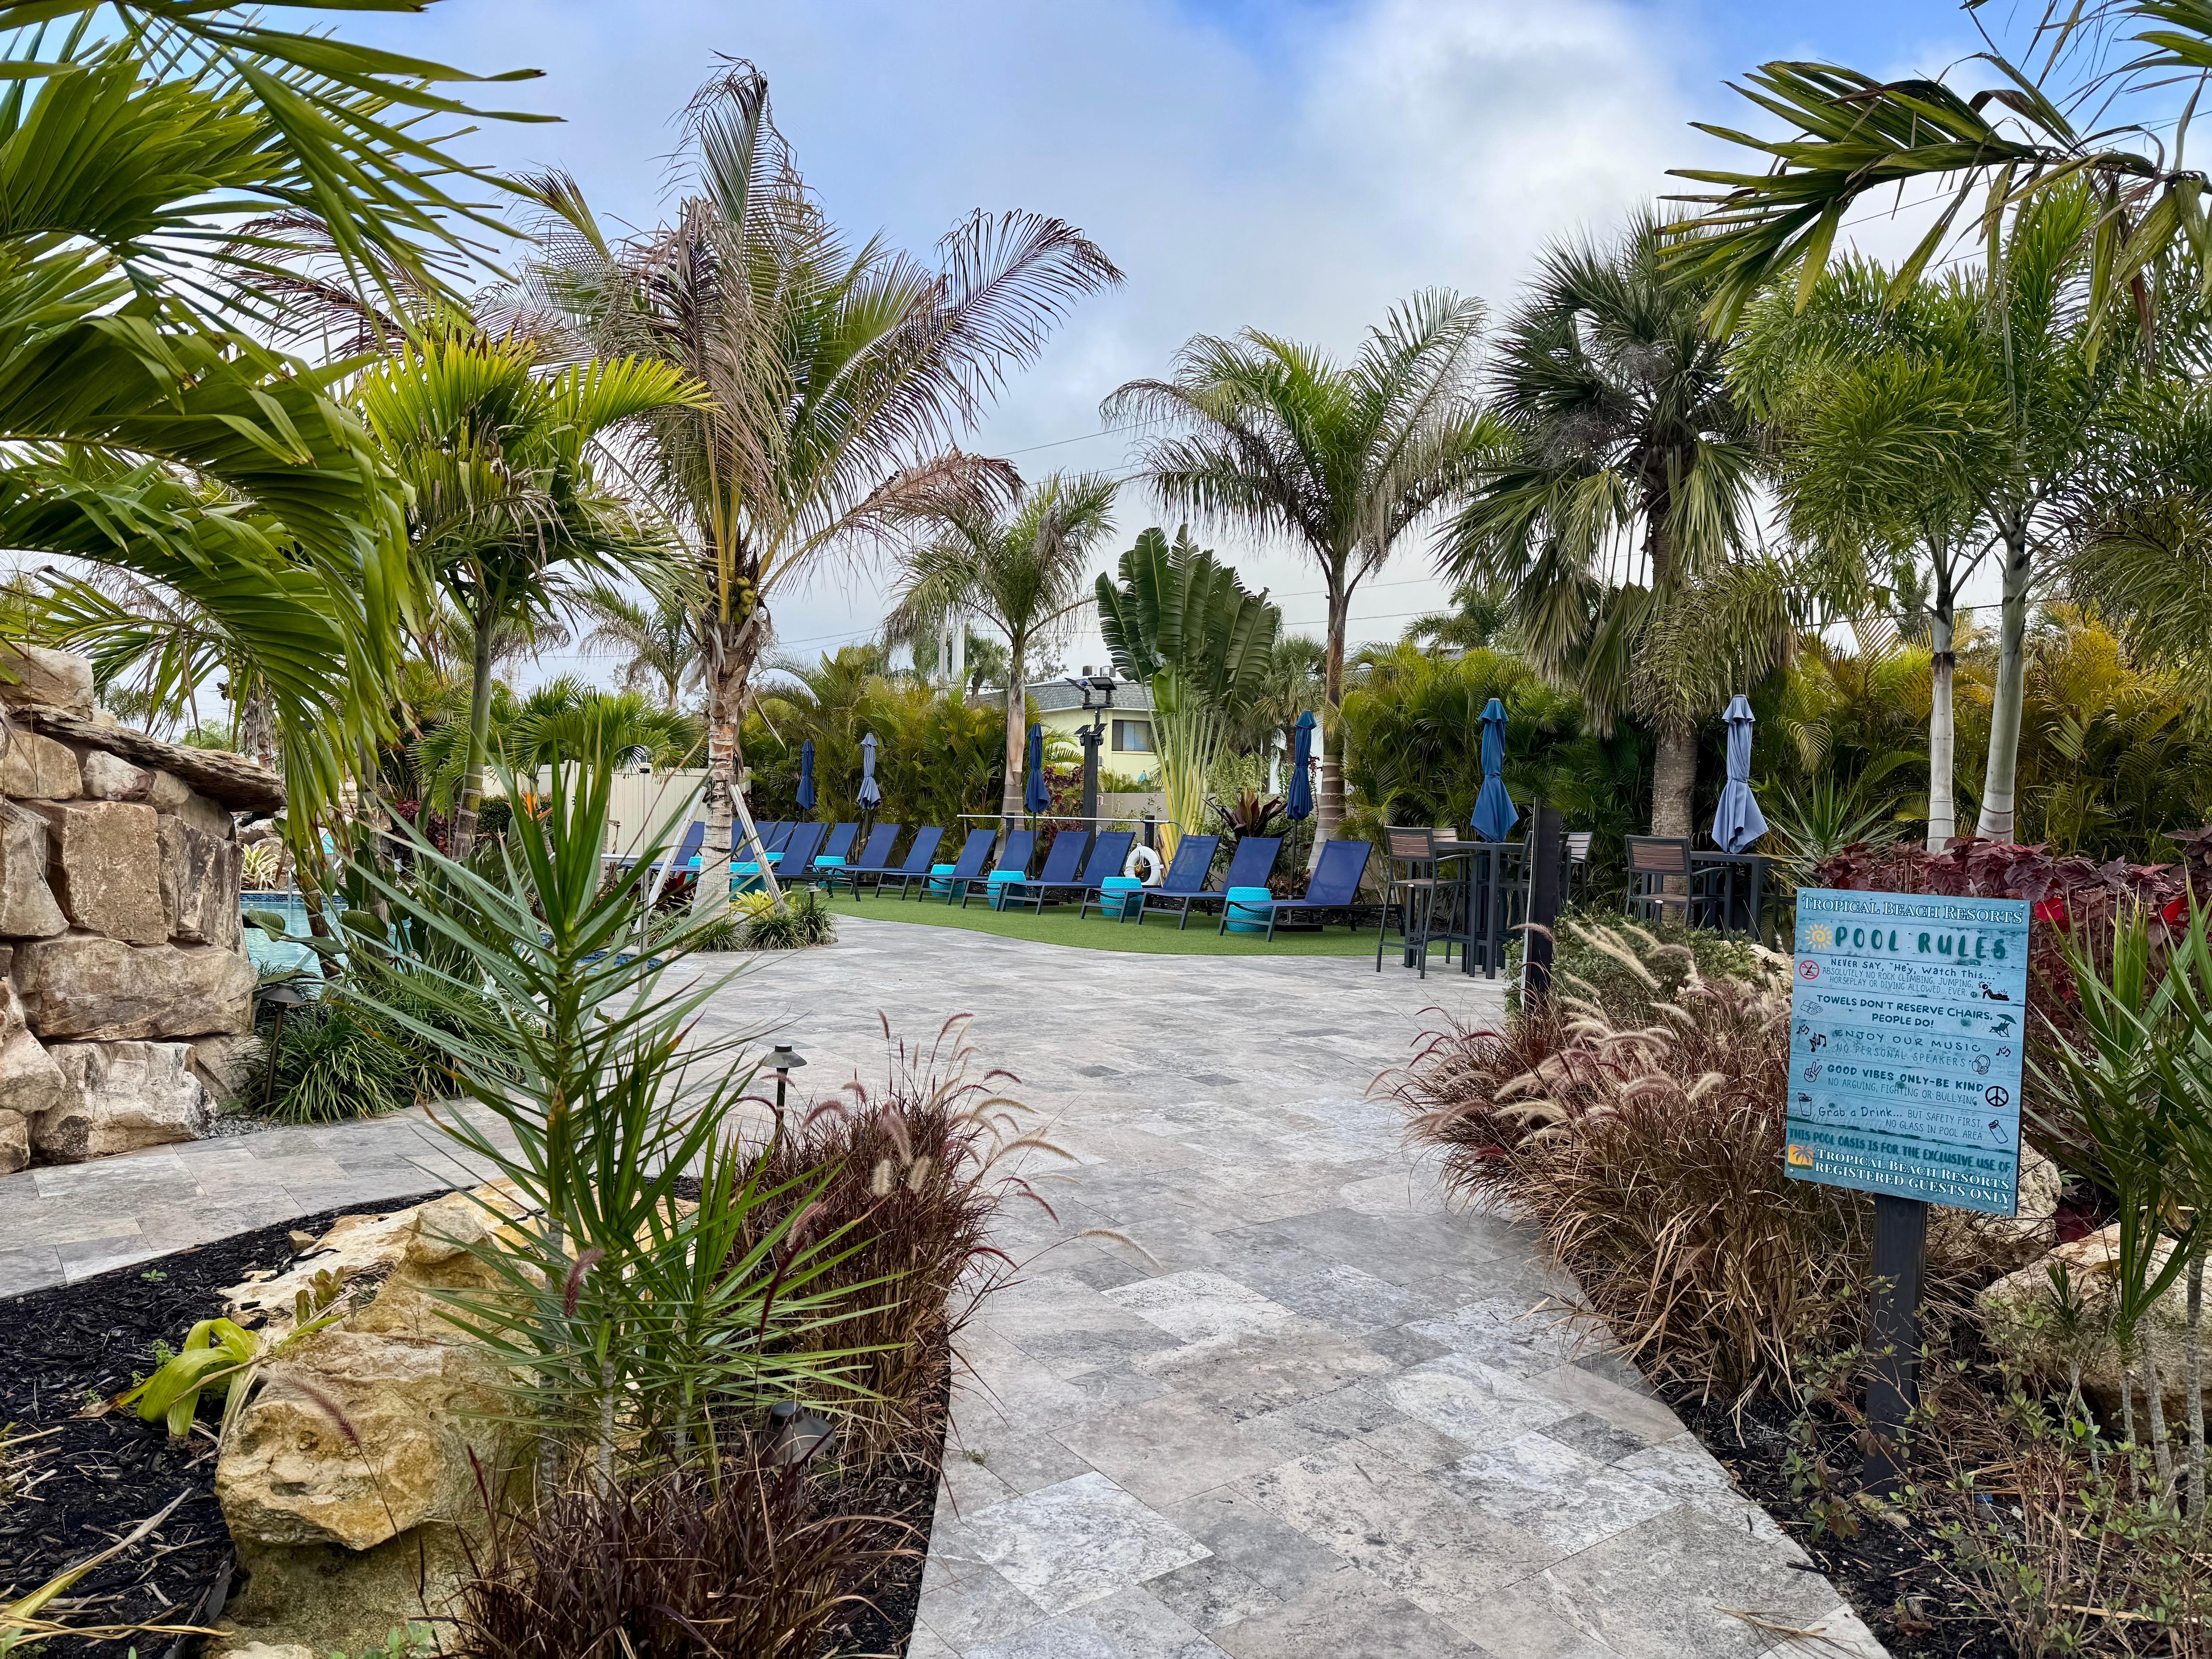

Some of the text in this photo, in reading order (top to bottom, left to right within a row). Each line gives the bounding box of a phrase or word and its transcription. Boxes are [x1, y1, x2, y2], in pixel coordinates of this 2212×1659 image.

[1802, 896, 2023, 923] TROPICAL BEACH RESORTS
[1836, 927, 2005, 959] POOL RULES
[1832, 959, 1857, 968] NEVER
[1863, 962, 1884, 972] SAY,
[1823, 967, 1863, 977] ABSOLUTELY
[1878, 972, 1894, 980] ROCK
[1898, 974, 1935, 984] CLIMBING,
[1939, 978, 1973, 988] JUMPING,
[1830, 976, 1866, 986] HORSEPLAY
[1881, 981, 1905, 990] DIVING
[1948, 987, 1967, 996] EVER.
[1817, 995, 1857, 1006] TOWELS
[1860, 999, 1893, 1010] DON'T
[1897, 1003, 1943, 1015] RESERVE
[1872, 1013, 1934, 1028] PEOPLE DO!
[1832, 1030, 1981, 1052] ENJOY OUR MUSIC
[1837, 1043, 1965, 1067] NO PERSONAL SPEAKERS
[1827, 1064, 1857, 1075] GOOD
[1863, 1069, 1894, 1080] VIBES
[1955, 1081, 1983, 1092] KIND
[1828, 1078, 1977, 1106] NO ARGUING, FIGHTING OR BULLYING
[1819, 1106, 1845, 1117] Grab
[1861, 1106, 1902, 1117] Drink...
[1908, 1110, 1923, 1119] BUT
[1926, 1112, 1955, 1123] SAFETY
[1958, 1117, 1983, 1129] FIRST,
[1886, 1119, 1982, 1140] NO GLASS IN POOL AREA
[1790, 1128, 1810, 1141] THIS
[1813, 1132, 1834, 1145] POOL
[1838, 1136, 1865, 1149] OASIS
[1868, 1140, 1878, 1151] IS
[1881, 1142, 1899, 1155] FOR
[1902, 1145, 1920, 1159] THE
[1923, 1149, 1973, 1167] EXCLUSIVE
[1977, 1158, 1995, 1170] USE
[1817, 1148, 2009, 1190] TROPICAL BEACH RESORTS
[1816, 1162, 2011, 1205] REGISTERED GUESTS ONLY
